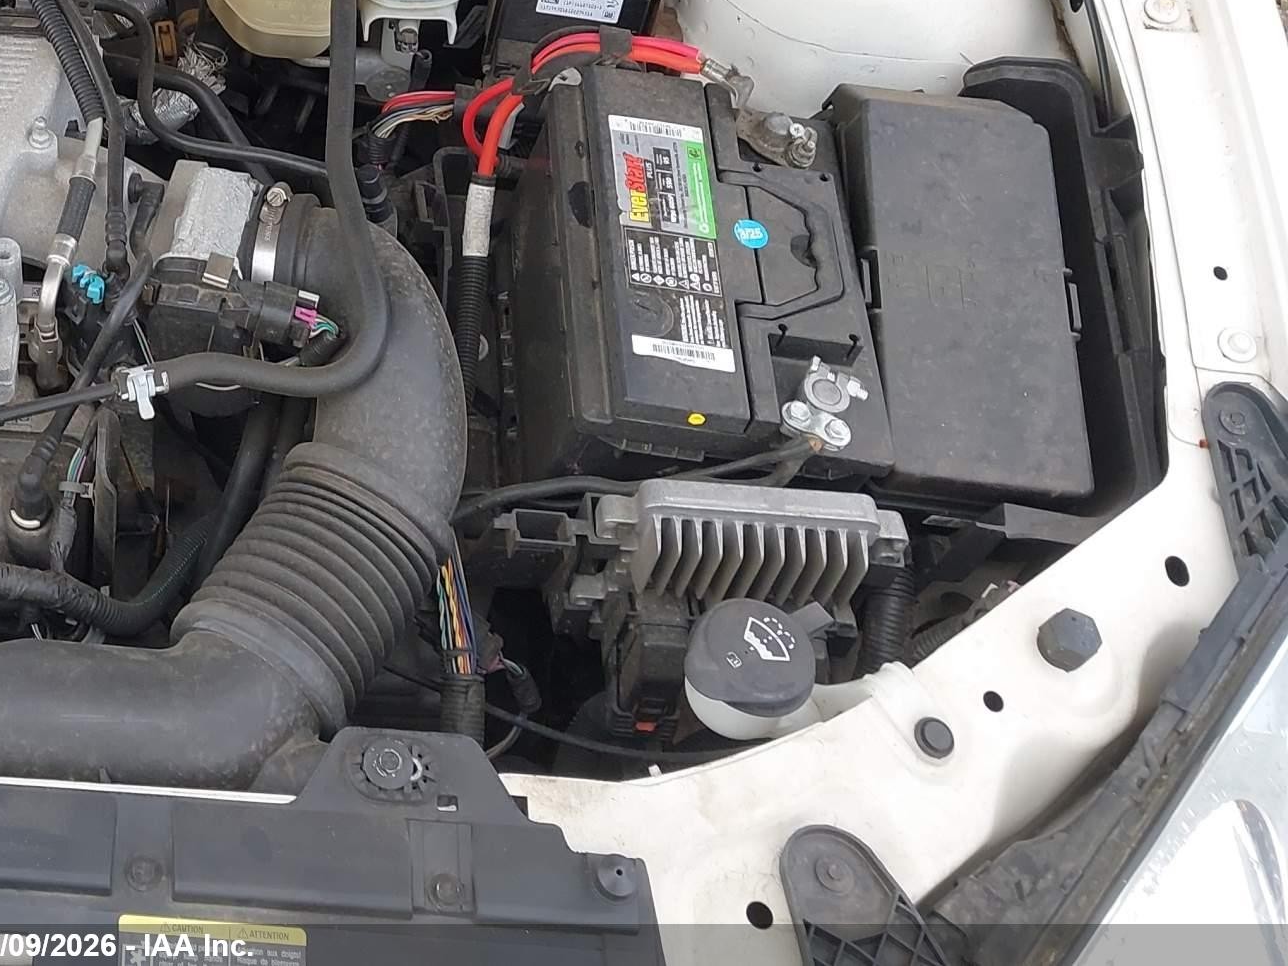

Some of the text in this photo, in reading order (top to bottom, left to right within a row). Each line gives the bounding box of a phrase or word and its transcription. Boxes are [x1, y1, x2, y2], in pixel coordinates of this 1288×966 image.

[622, 151, 650, 224] EverStart
[171, 924, 204, 934] CAUTION
[249, 930, 289, 940] ATTENTION
